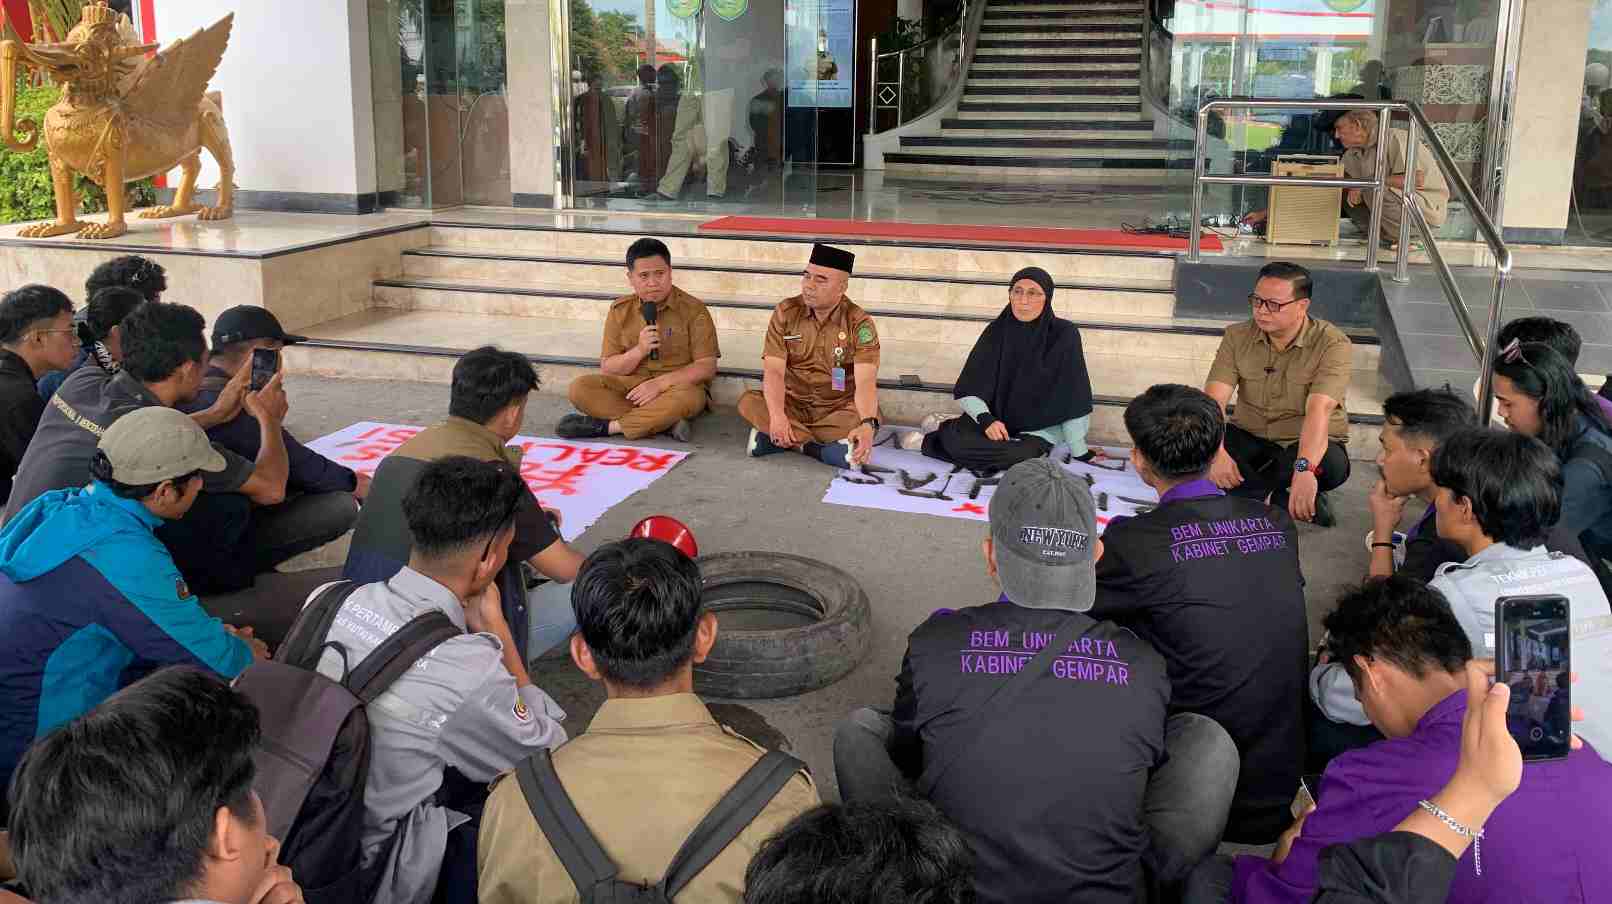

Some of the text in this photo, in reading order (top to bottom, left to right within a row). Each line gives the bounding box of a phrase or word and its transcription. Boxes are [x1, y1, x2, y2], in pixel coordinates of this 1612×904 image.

[1020, 527, 1088, 551] NEW YORK
[1171, 517, 1275, 541] BEM UNIKARTA
[1171, 535, 1287, 562] KABINET GEMPAR
[971, 631, 1119, 657] BEM UNIARTA
[1052, 660, 1129, 686] GEMPAR
